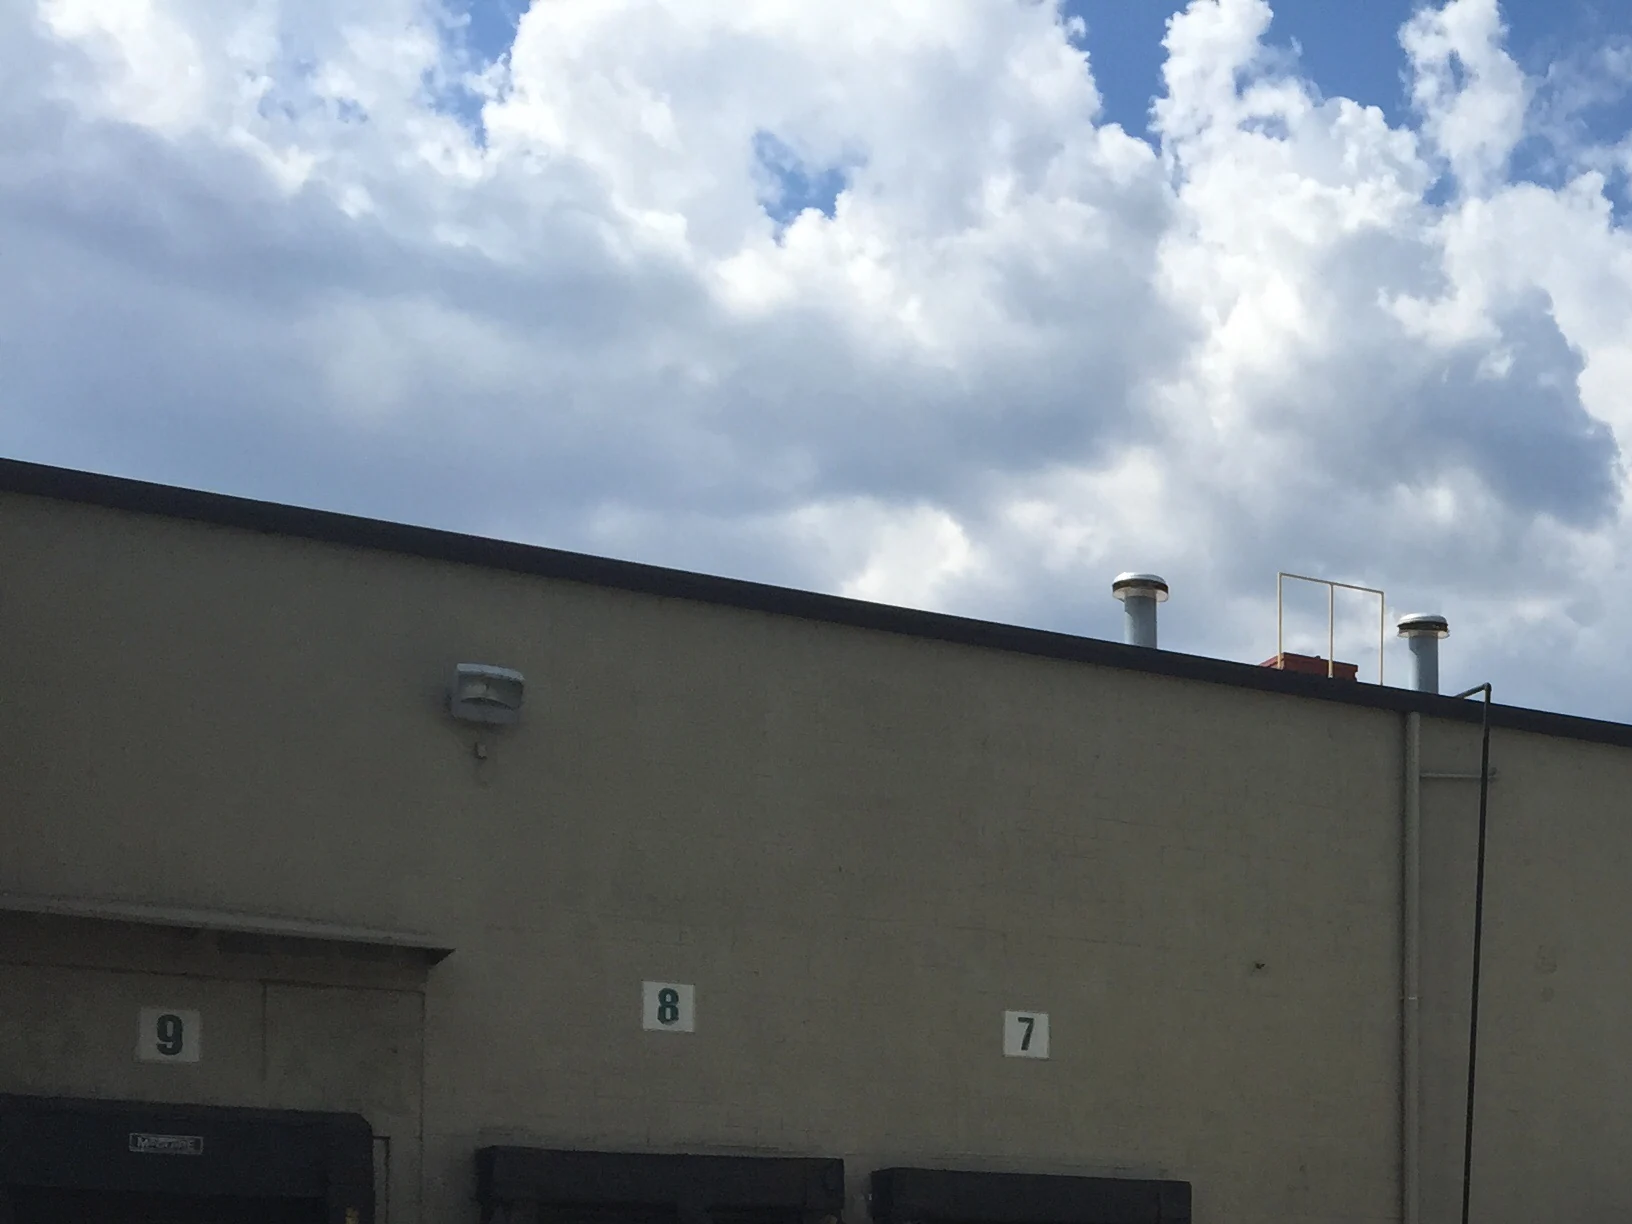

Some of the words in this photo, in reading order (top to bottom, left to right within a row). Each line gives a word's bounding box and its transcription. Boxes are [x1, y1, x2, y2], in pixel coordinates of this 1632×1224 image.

[657, 987, 679, 1025] 8
[156, 1014, 183, 1055] 9
[1017, 1016, 1034, 1051] 7
